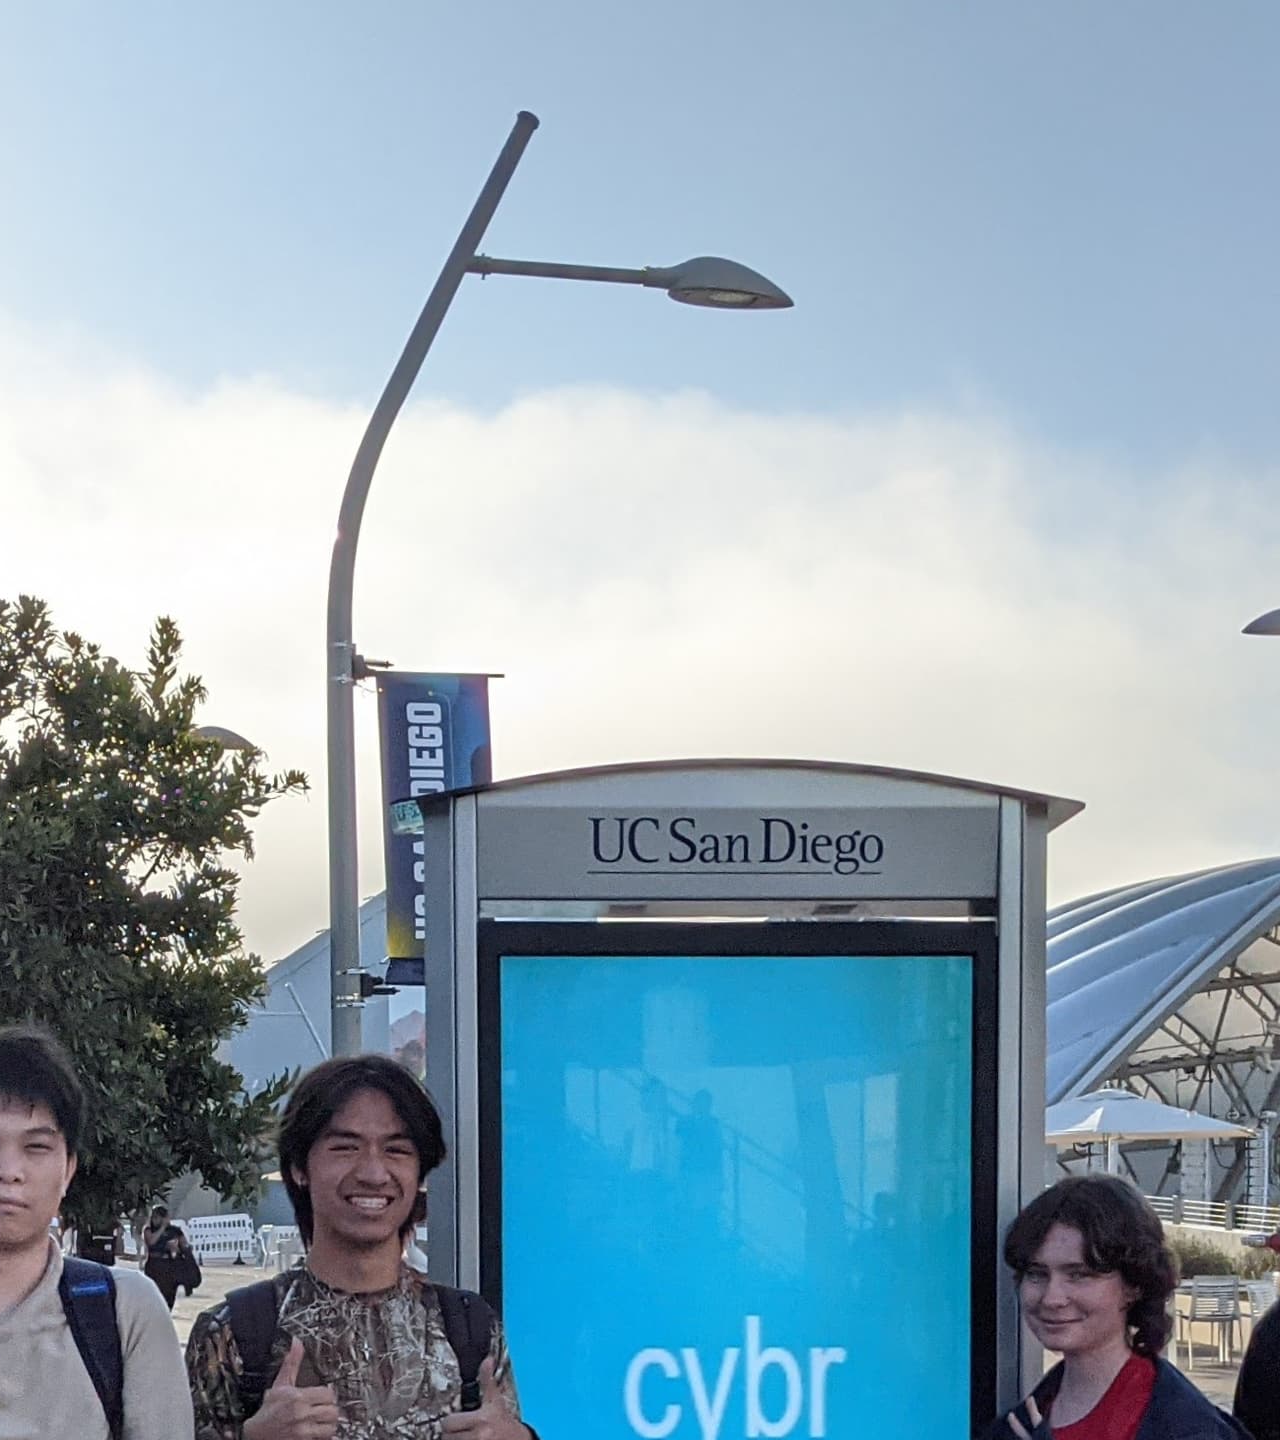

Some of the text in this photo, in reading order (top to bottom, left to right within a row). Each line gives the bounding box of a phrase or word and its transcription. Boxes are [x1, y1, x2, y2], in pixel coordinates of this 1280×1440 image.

[589, 816, 886, 875] UC San Diego
